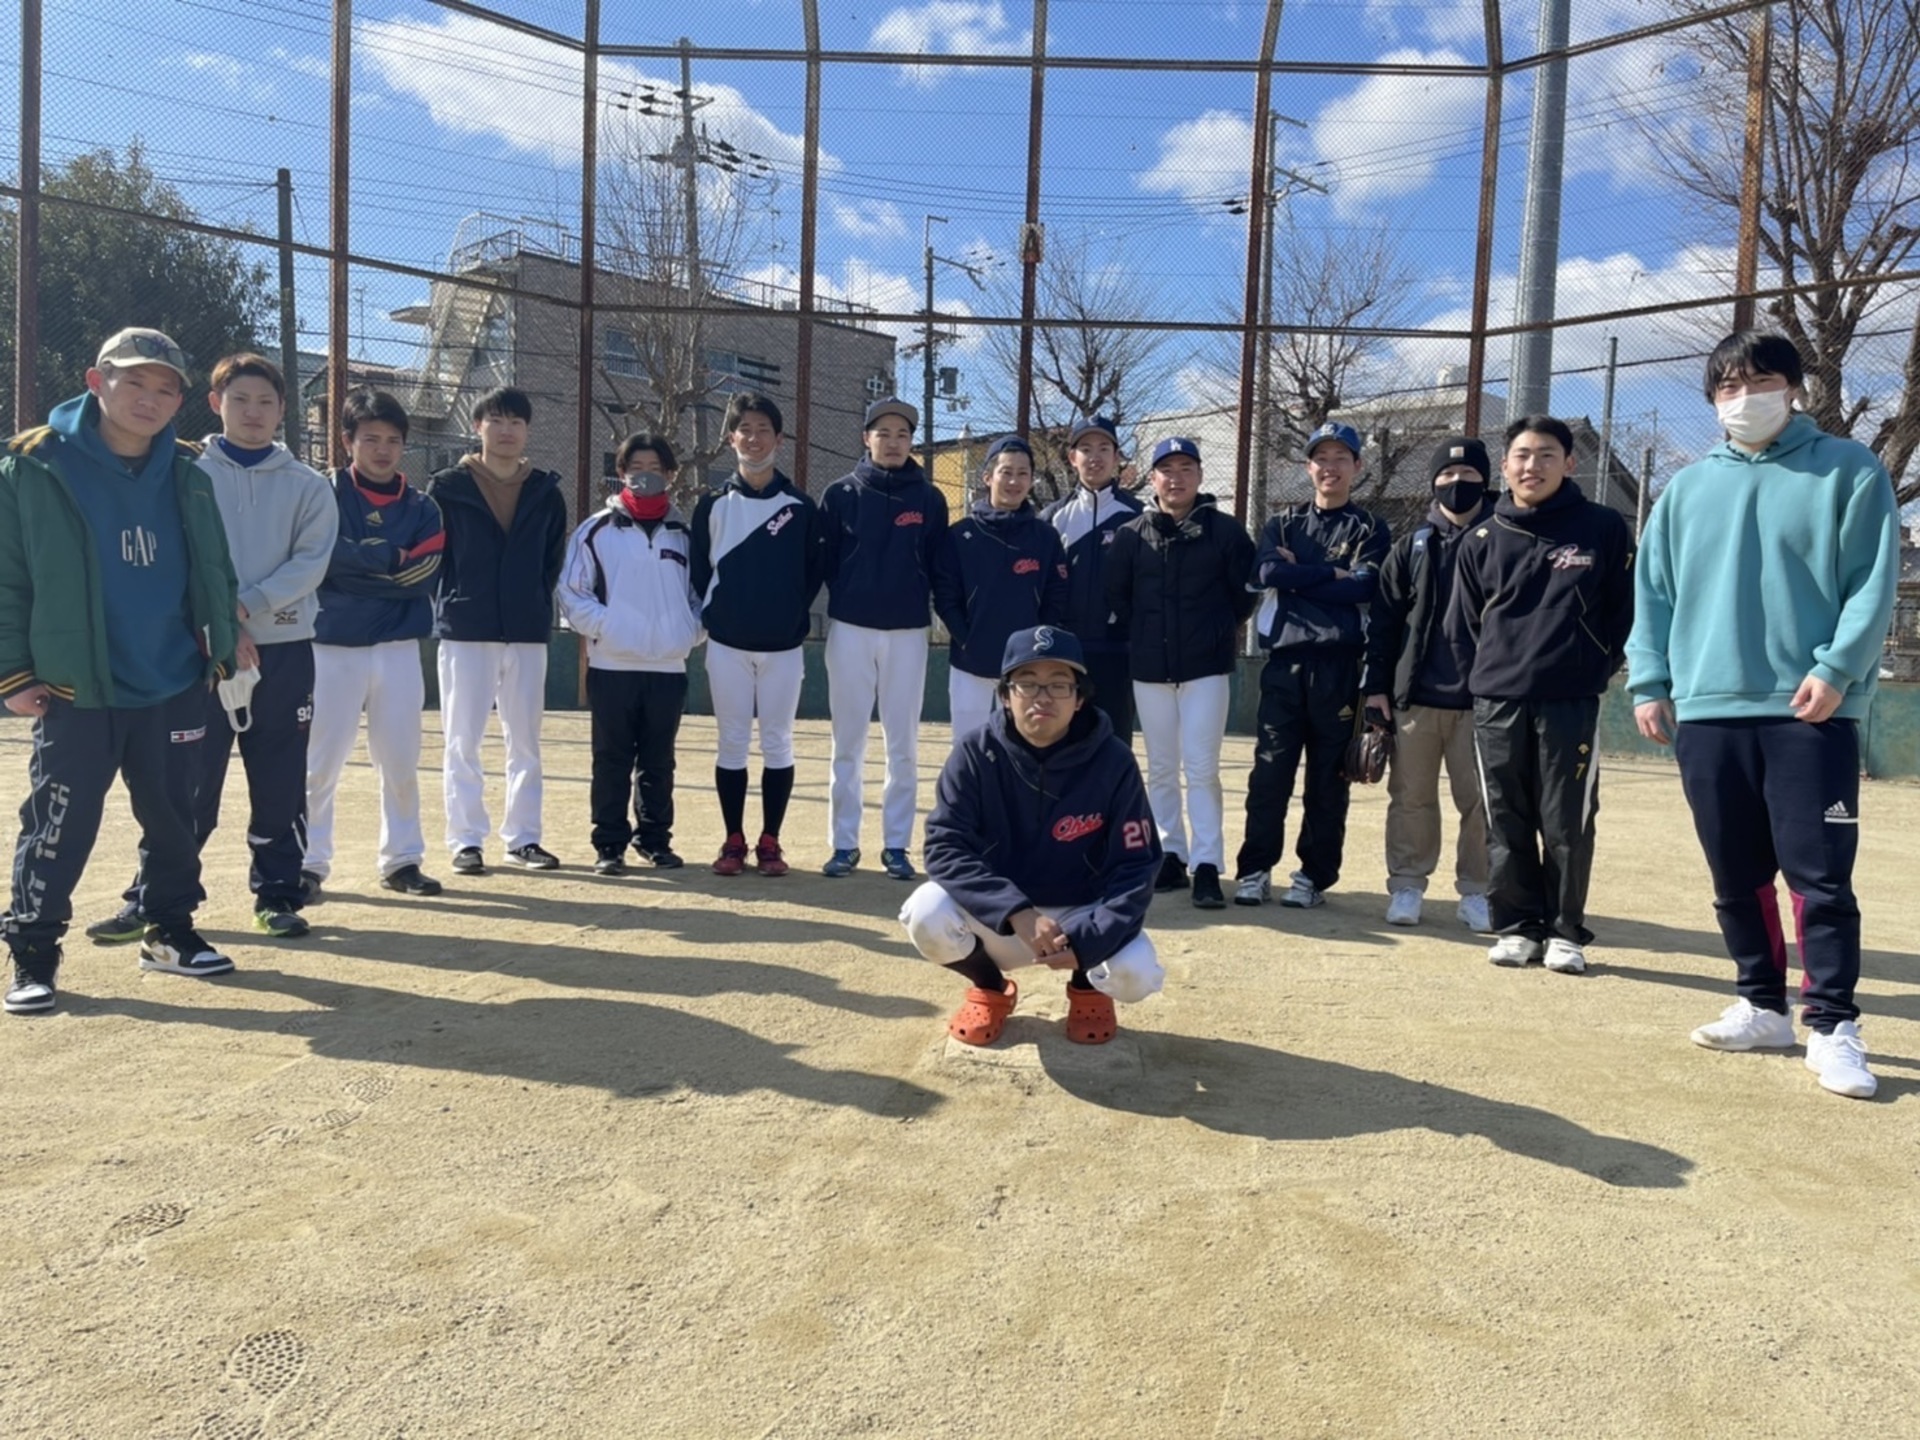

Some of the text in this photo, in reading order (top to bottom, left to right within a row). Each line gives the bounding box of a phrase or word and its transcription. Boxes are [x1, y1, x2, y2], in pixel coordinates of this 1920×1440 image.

[121, 525, 157, 567] GAP
[1032, 624, 1055, 652] S
[1575, 762, 1587, 781] 7
[34, 782, 70, 861] TECH
